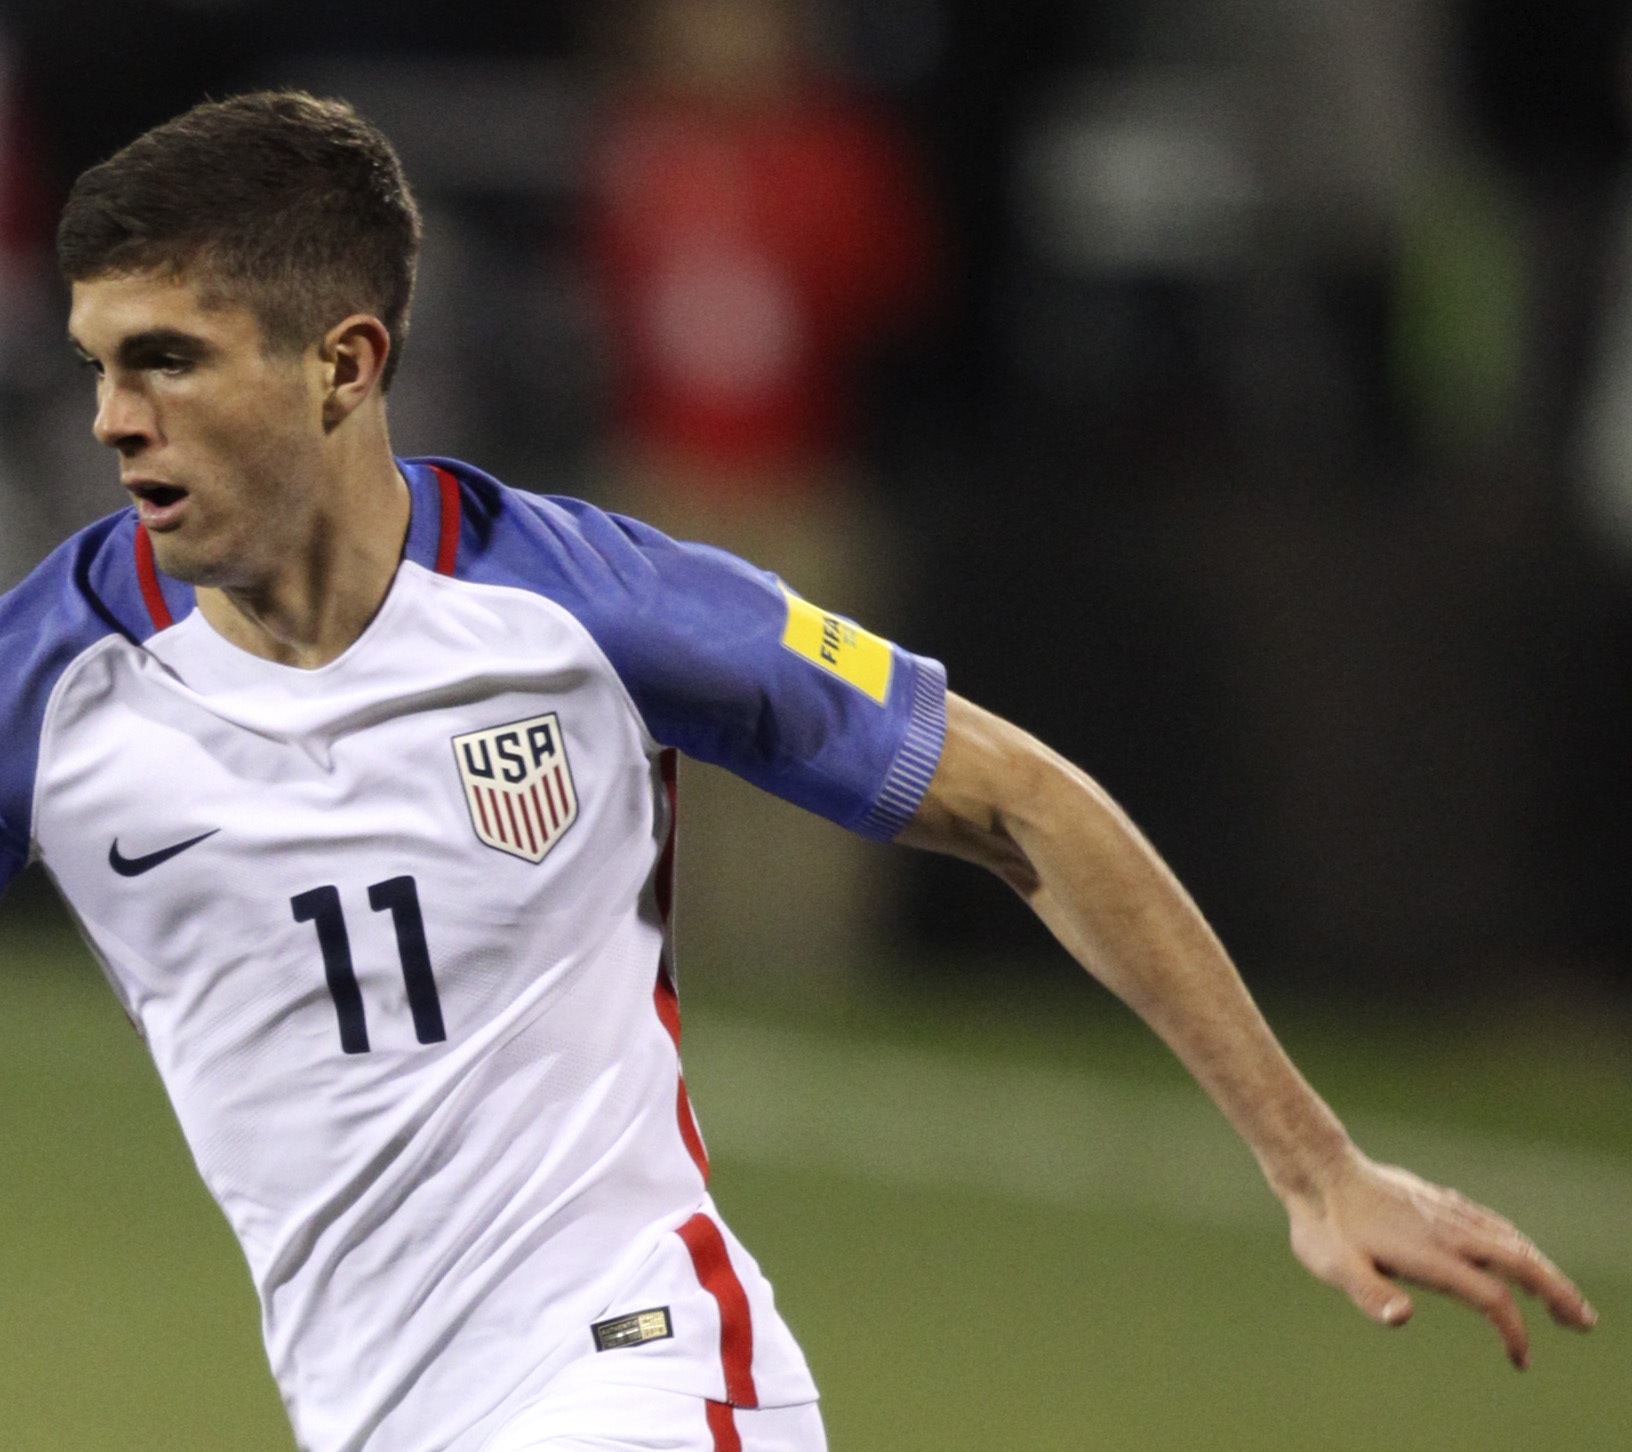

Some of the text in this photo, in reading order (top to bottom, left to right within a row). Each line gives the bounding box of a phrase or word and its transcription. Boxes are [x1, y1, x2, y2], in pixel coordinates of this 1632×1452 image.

[820, 616, 840, 665] FIFA
[463, 723, 556, 784] USA
[290, 875, 447, 1055] 11
